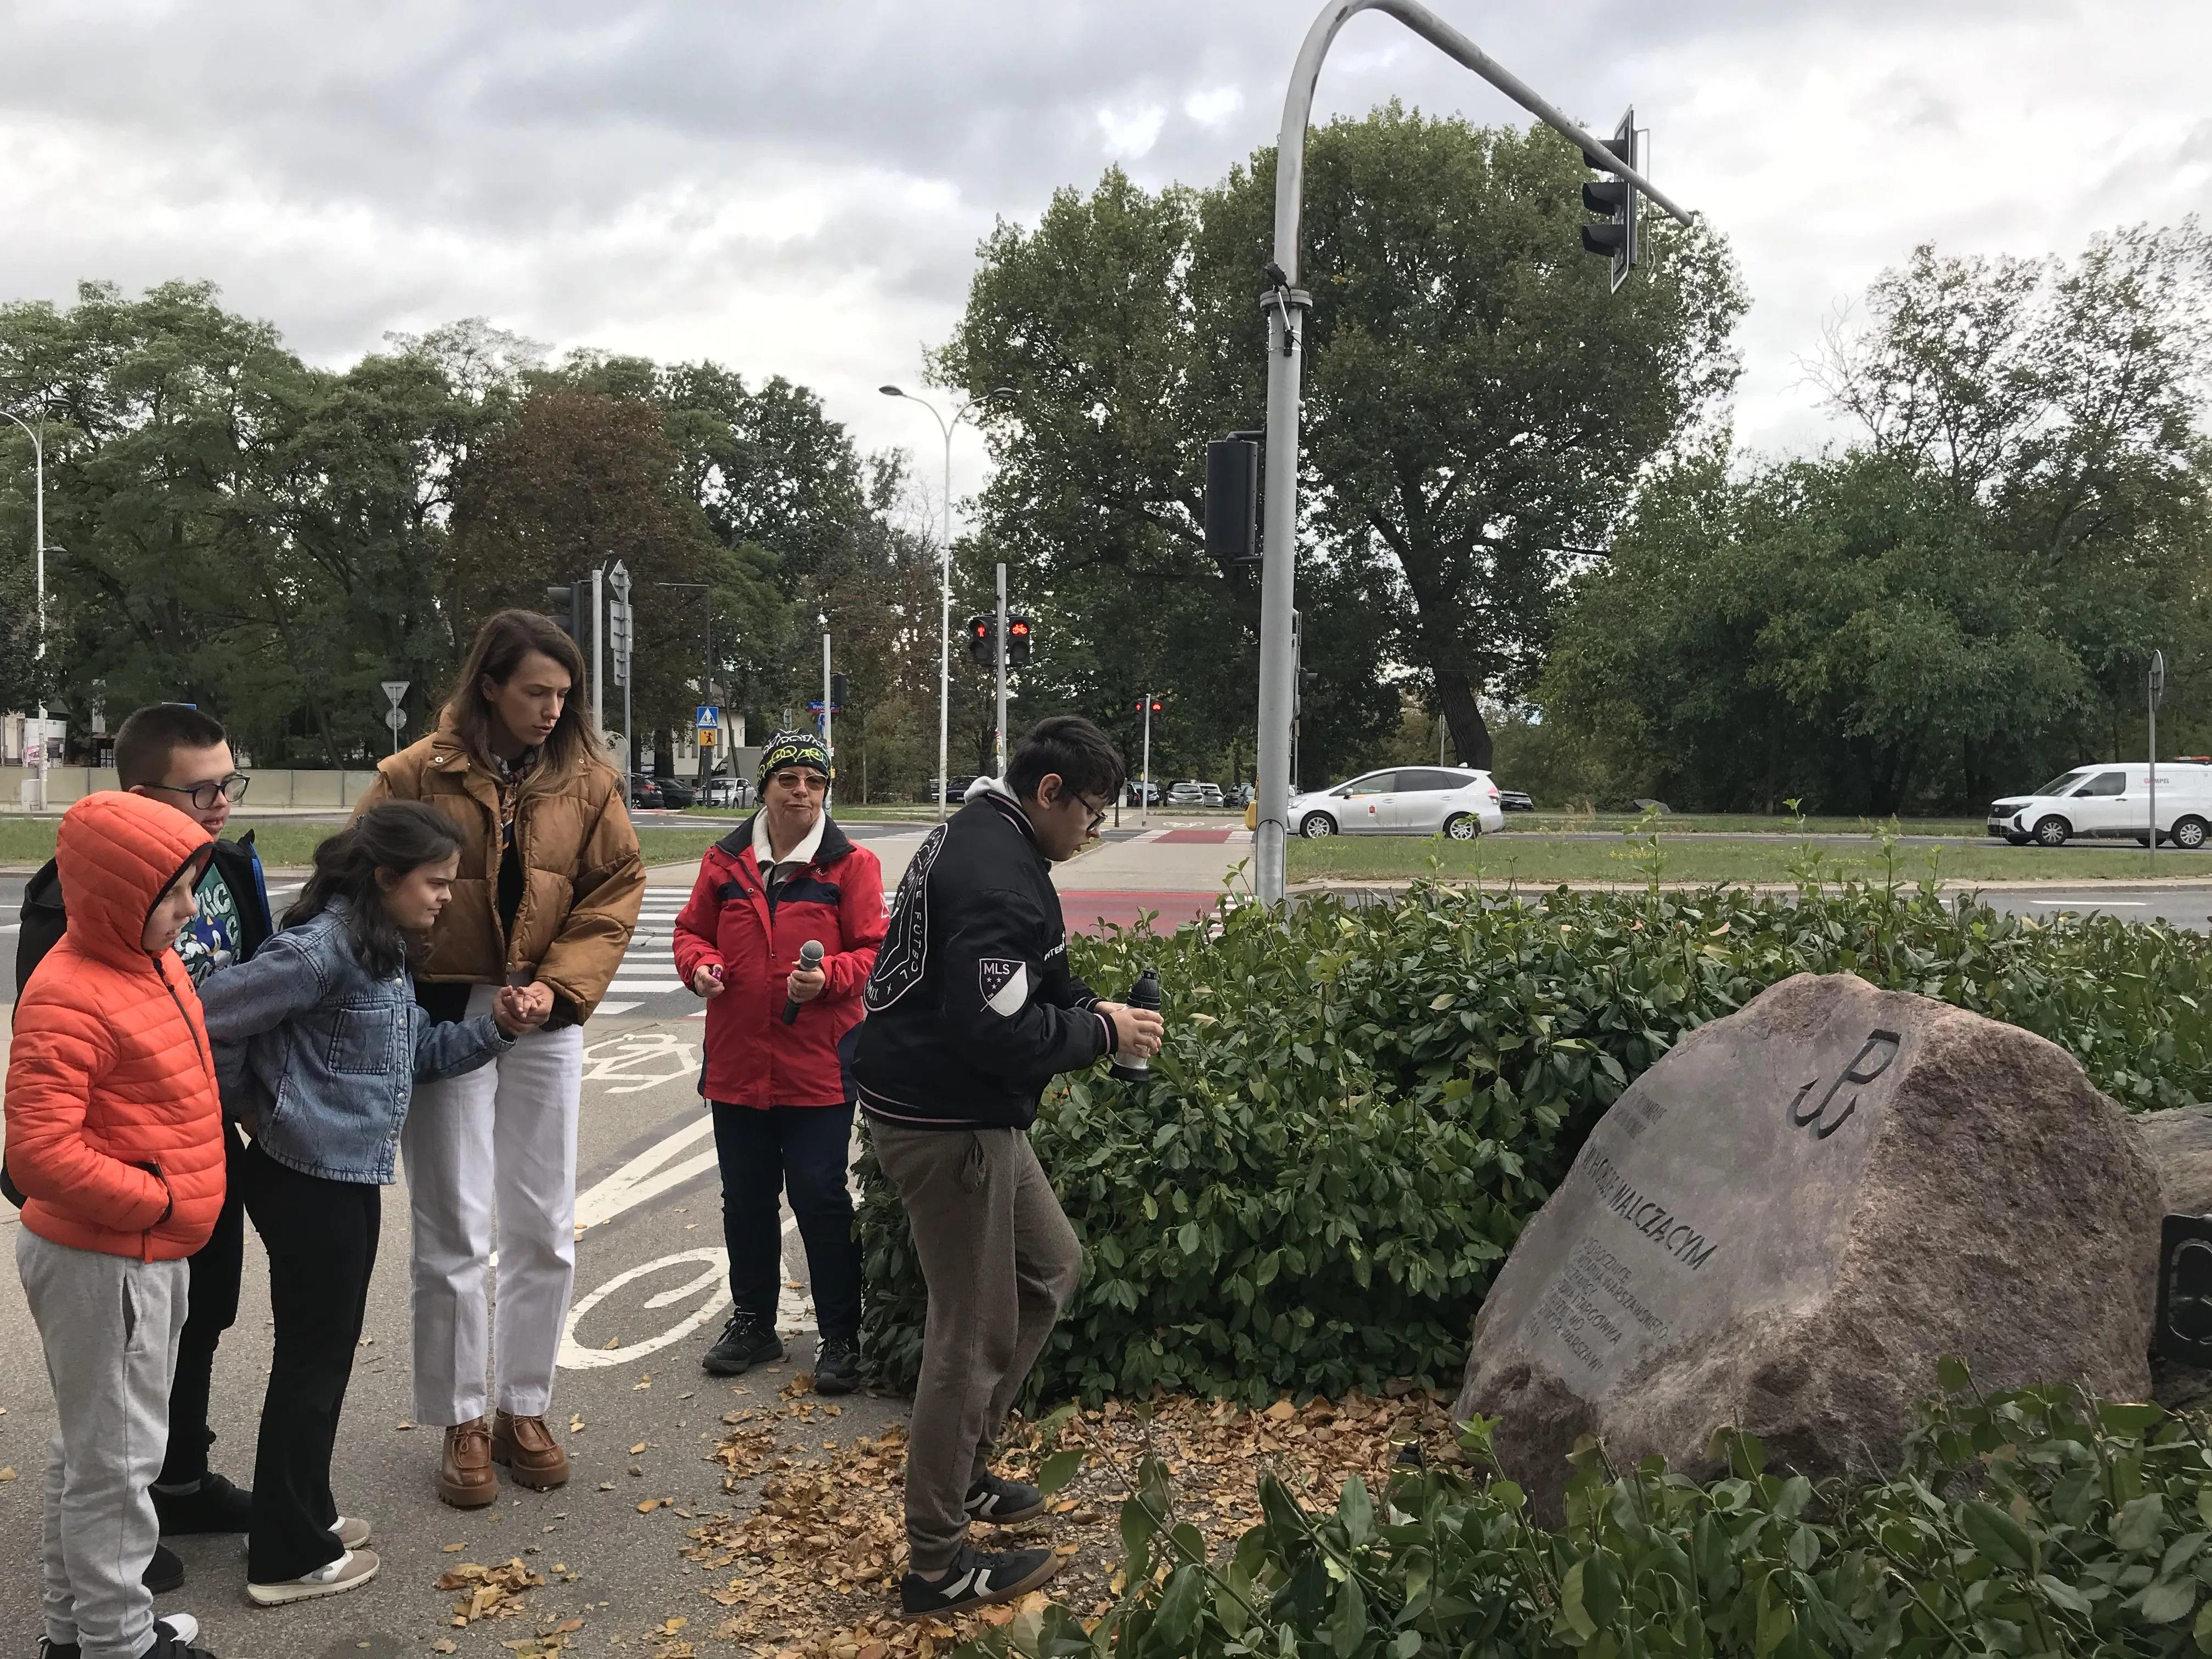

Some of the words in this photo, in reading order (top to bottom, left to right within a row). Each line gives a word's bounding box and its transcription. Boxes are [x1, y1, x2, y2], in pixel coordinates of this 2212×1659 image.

[984, 962, 1010, 975] MLS
[1608, 1180, 1718, 1271] WALCZĄCYM
[1602, 1276, 1669, 1340] WARSZAWSKIEGO
[1562, 1328, 1604, 1372] WARSZAWY
